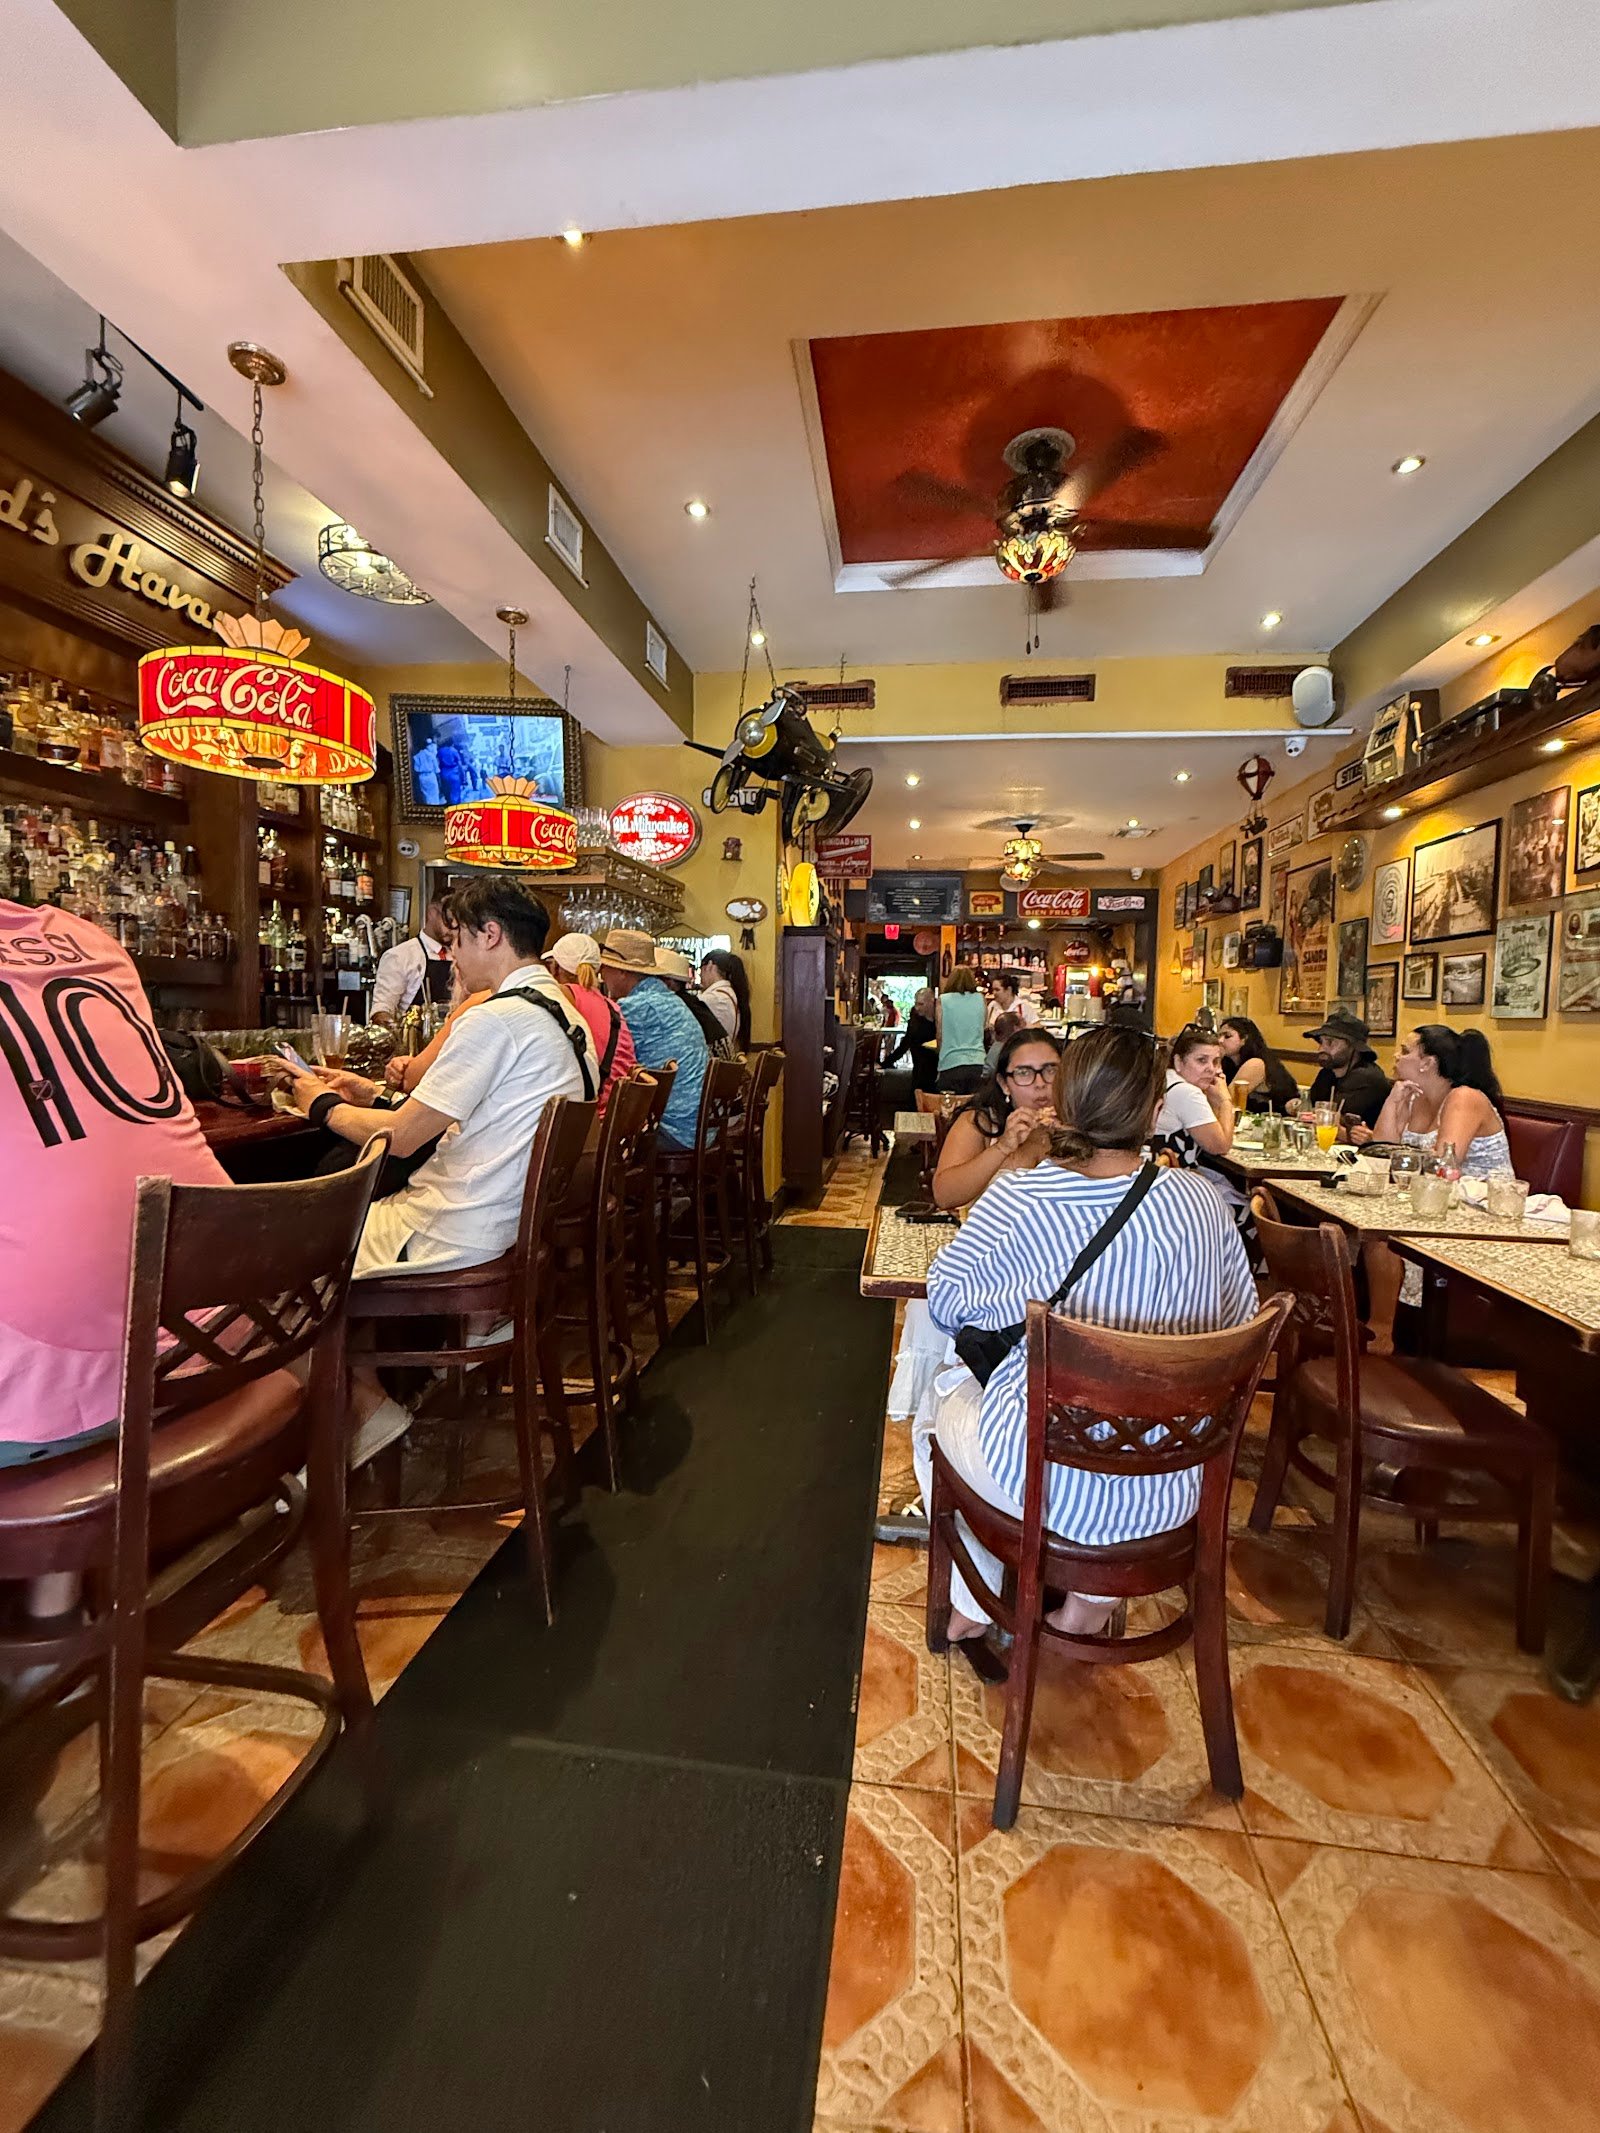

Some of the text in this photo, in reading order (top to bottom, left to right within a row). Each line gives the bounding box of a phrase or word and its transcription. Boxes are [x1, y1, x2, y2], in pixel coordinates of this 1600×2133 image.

[0, 479, 222, 632] d's Hava
[631, 815, 689, 834] Milwaukee
[0, 933, 96, 966] ESSI
[0, 976, 182, 1148] 10
